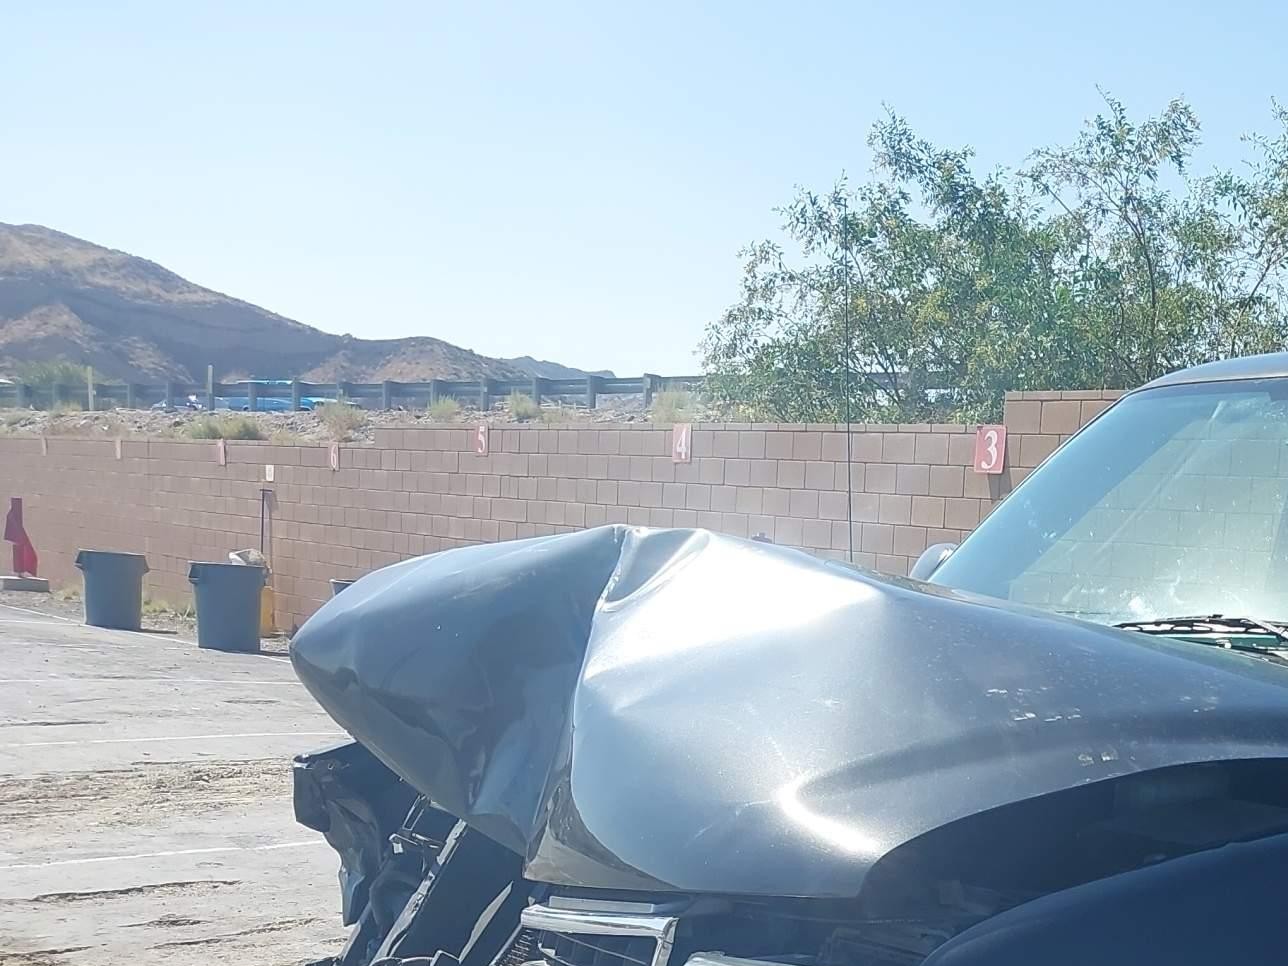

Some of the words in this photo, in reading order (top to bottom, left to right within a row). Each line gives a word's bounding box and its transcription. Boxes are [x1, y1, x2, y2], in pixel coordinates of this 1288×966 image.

[477, 425, 486, 453] 5
[676, 427, 687, 459] 4
[980, 429, 998, 470] 3
